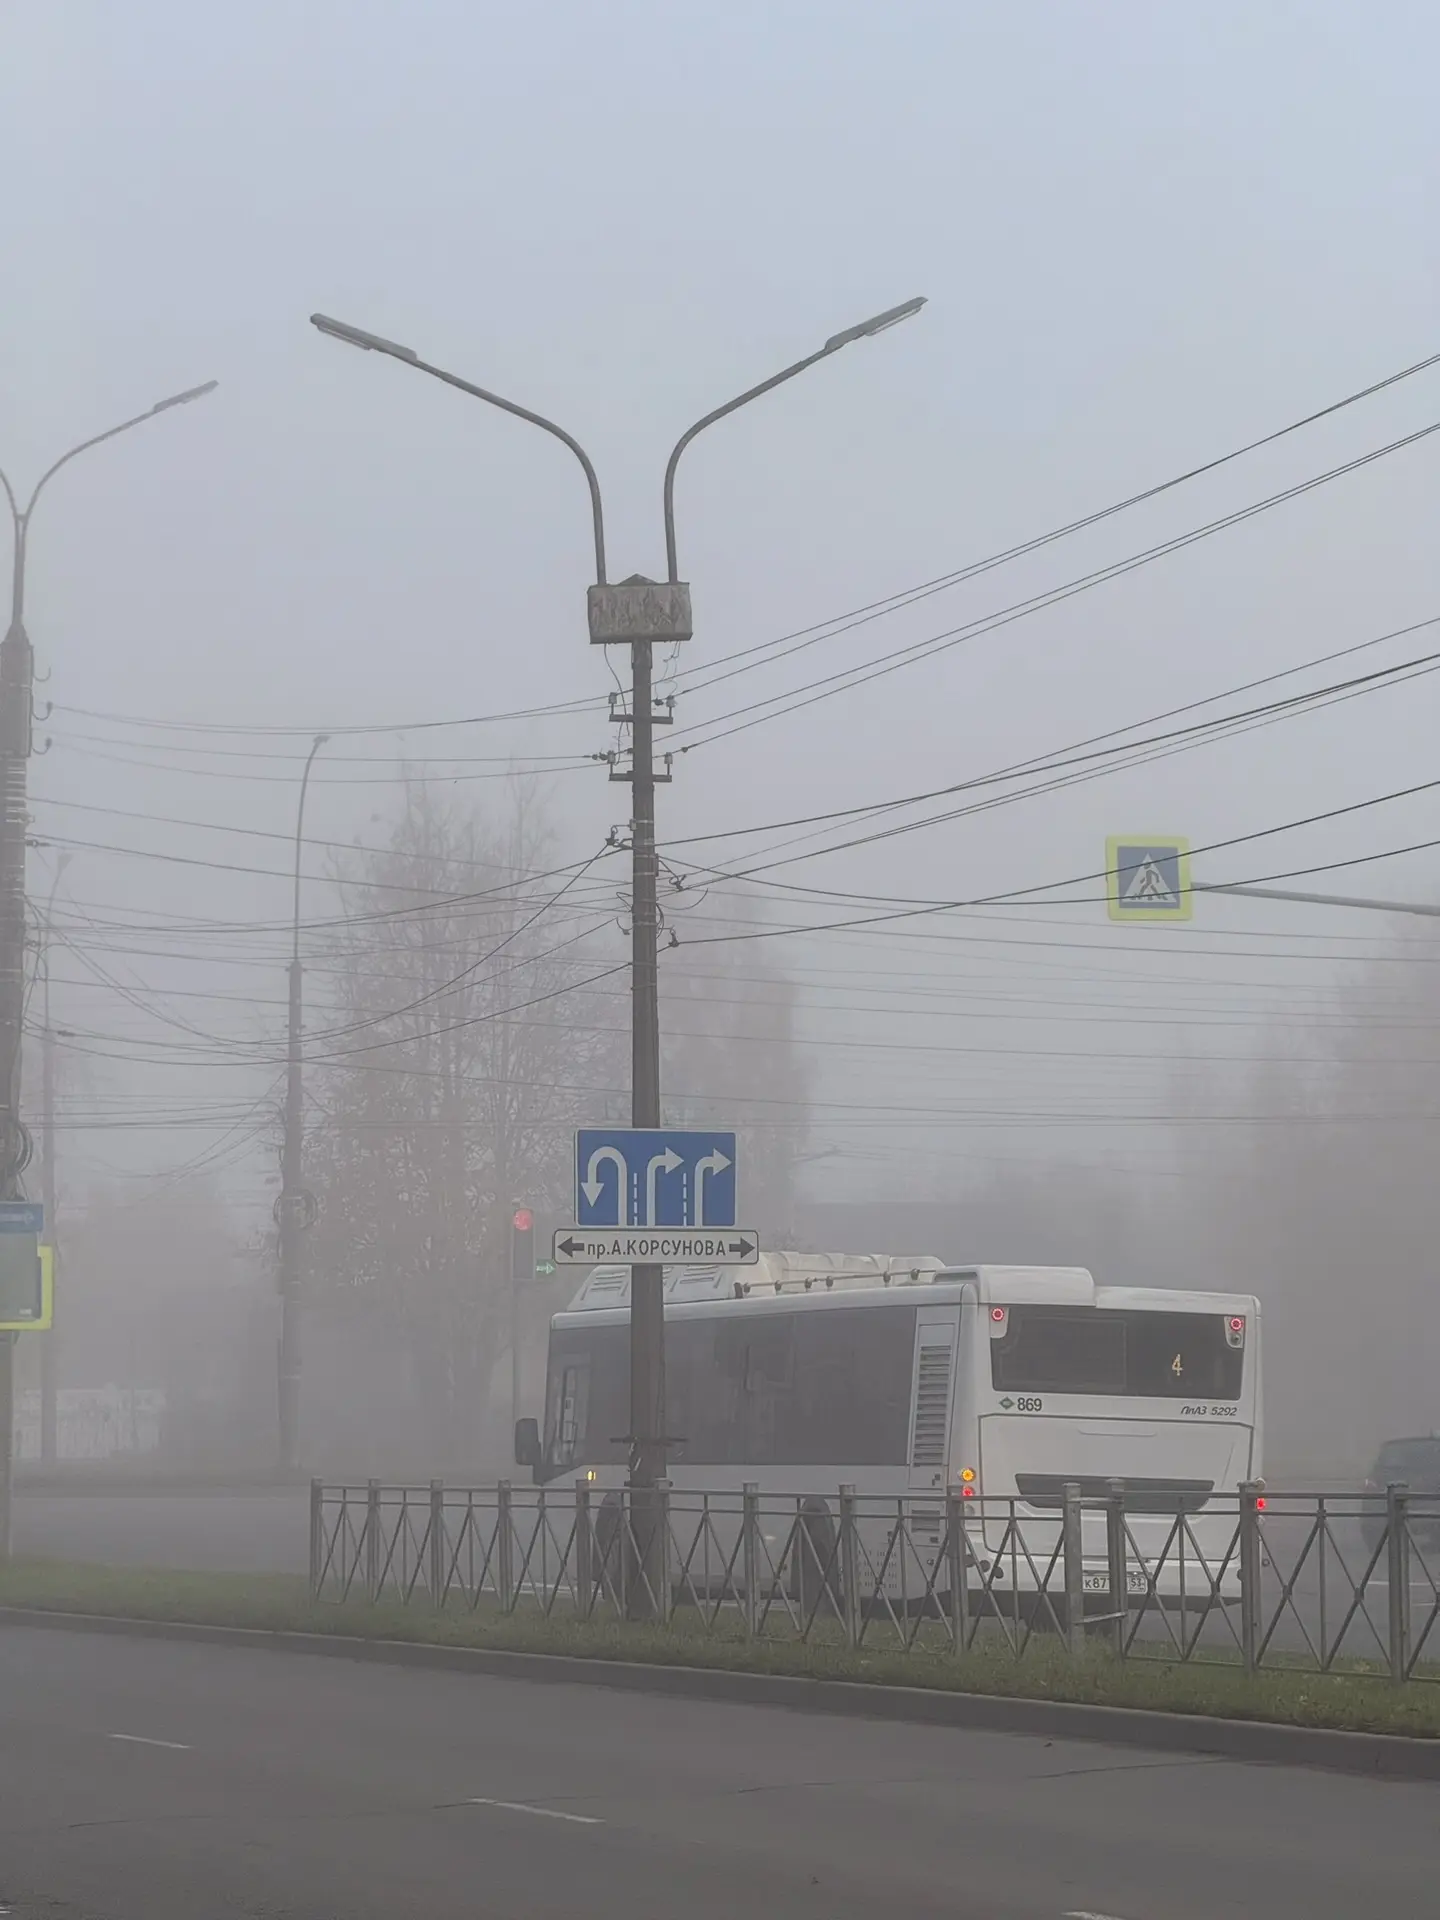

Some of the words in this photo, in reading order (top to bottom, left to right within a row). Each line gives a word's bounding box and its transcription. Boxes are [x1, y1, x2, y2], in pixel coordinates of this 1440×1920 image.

[587, 1239, 726, 1259] пр.А.КОРСУНОВА
[1171, 1353, 1184, 1377] 4
[1017, 1397, 1042, 1412] 869
[1211, 1406, 1238, 1416] 5292
